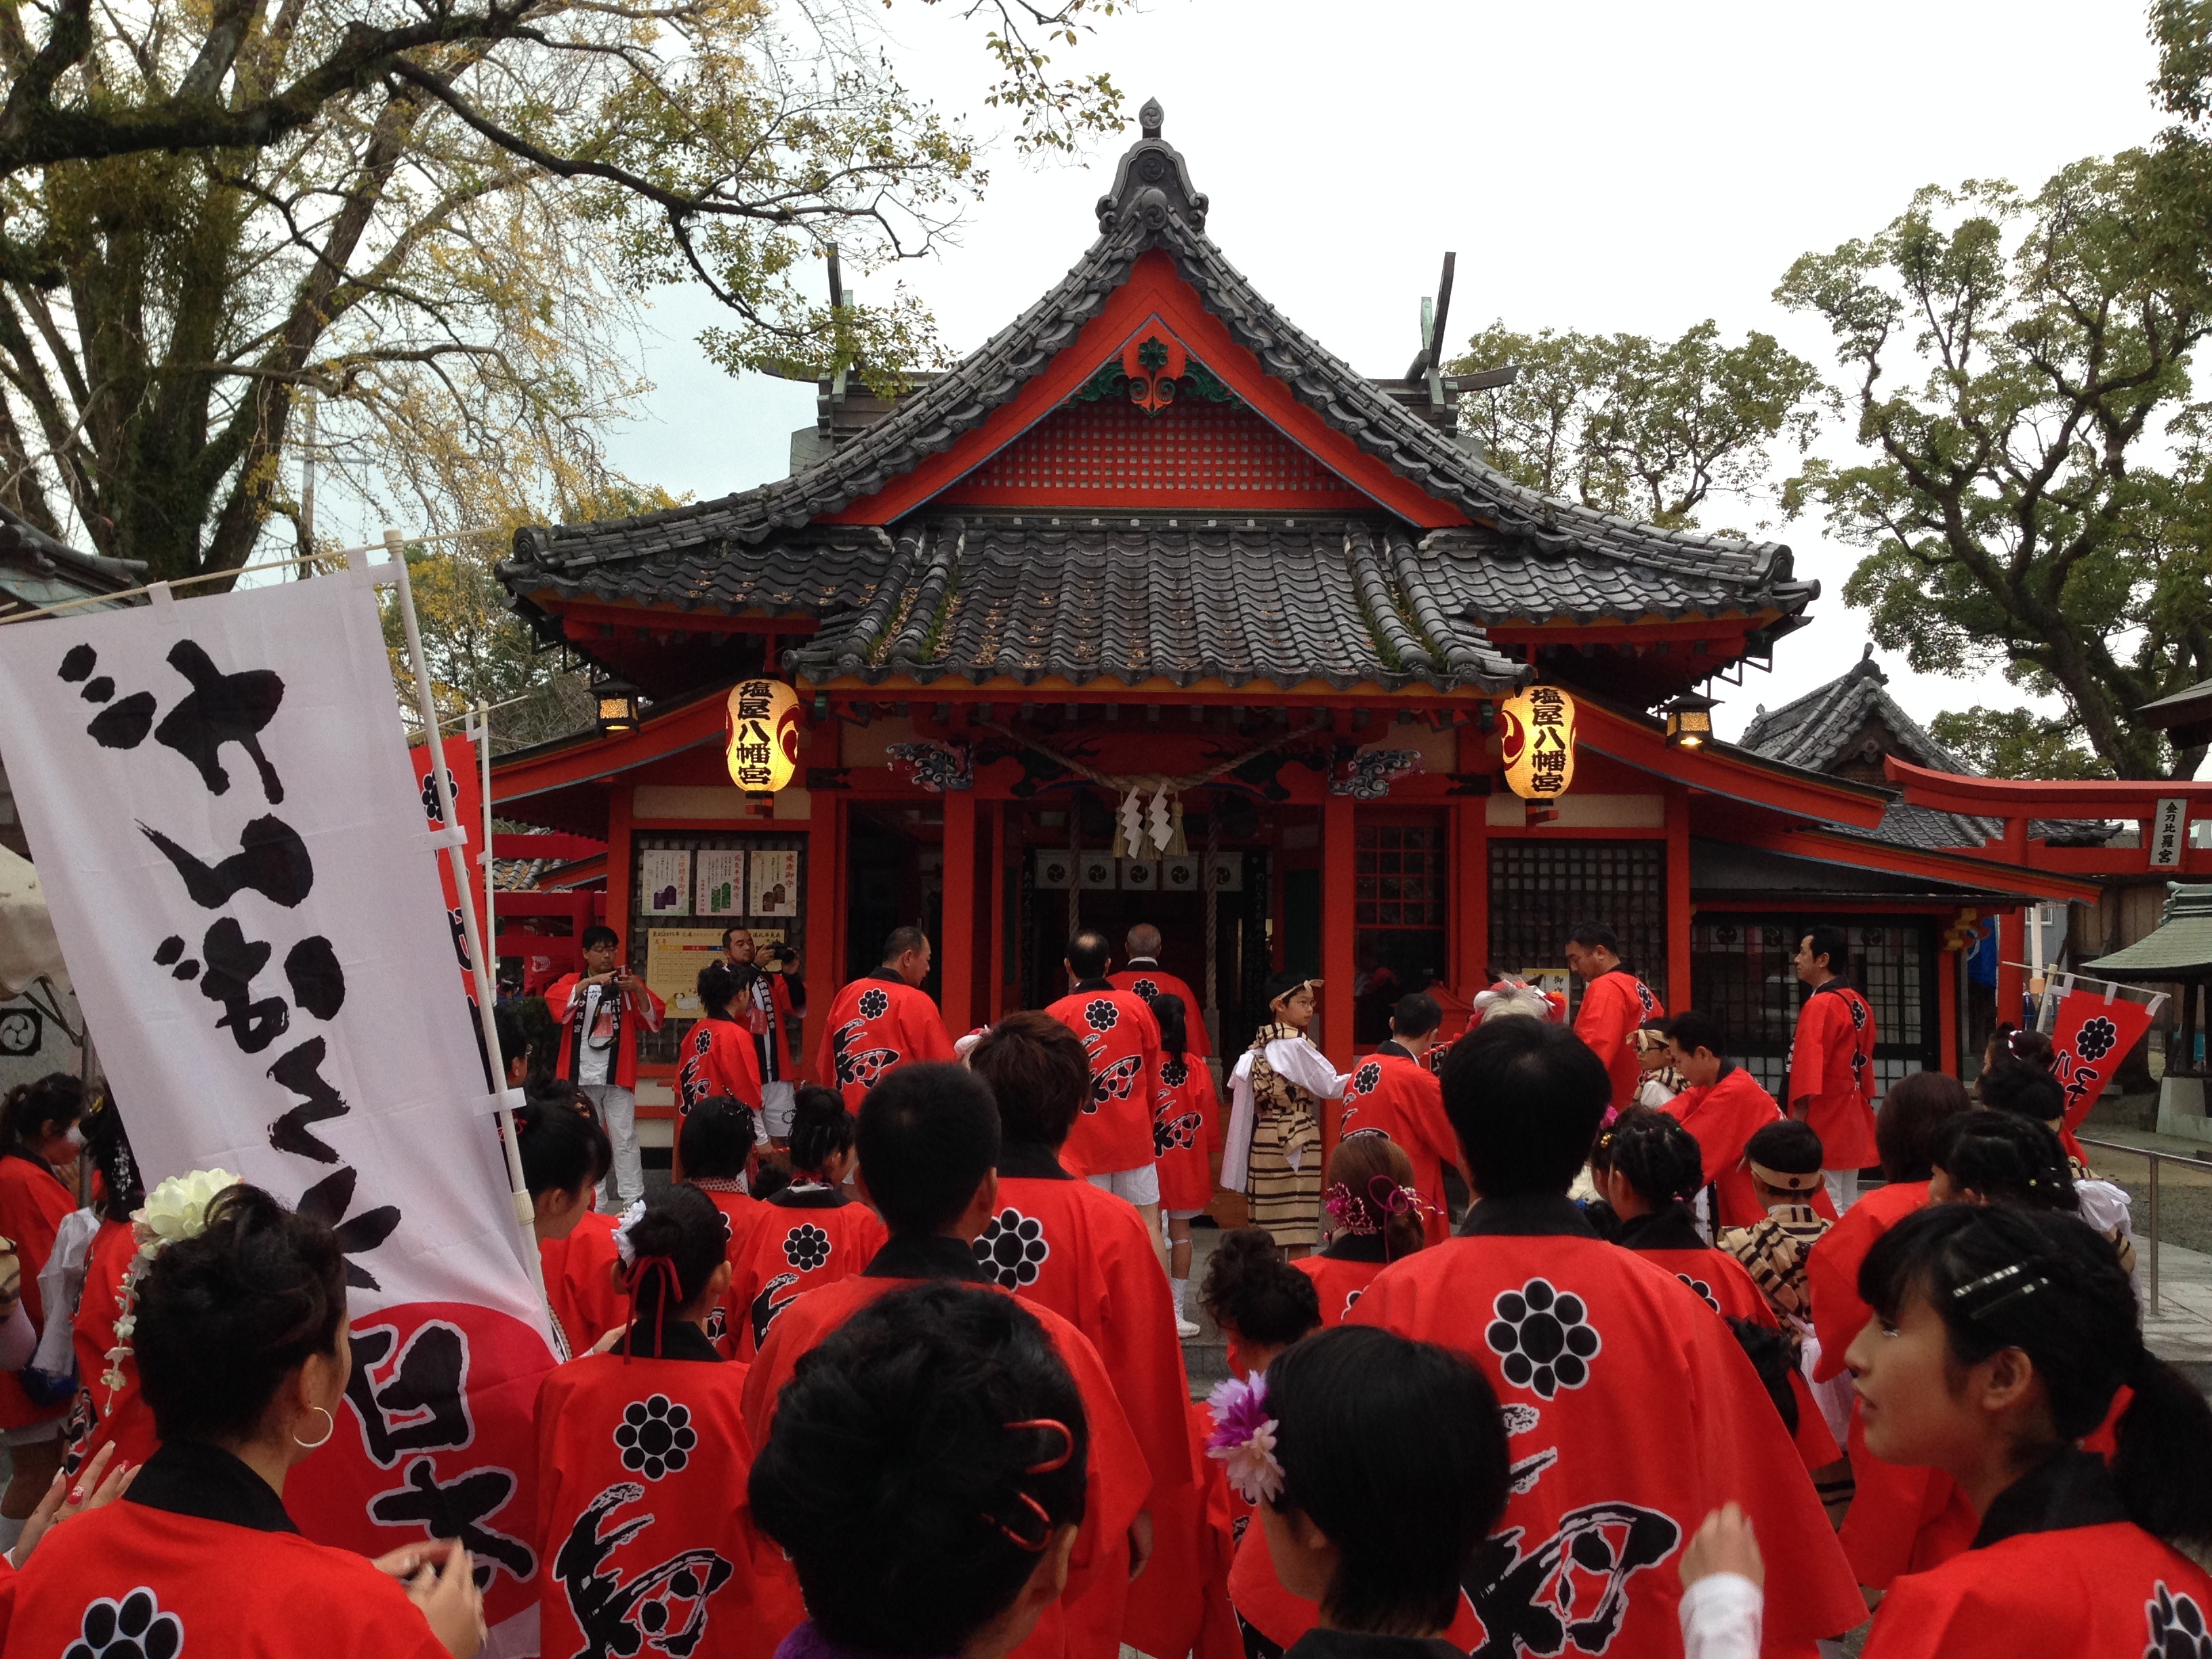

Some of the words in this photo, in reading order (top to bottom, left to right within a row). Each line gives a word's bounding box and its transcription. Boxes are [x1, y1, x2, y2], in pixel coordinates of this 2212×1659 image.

[737, 681, 773, 785] 塩屋八幡宮
[1530, 688, 1566, 792] 塩屋八幡宮
[2158, 802, 2178, 863] 金刀比羅宮
